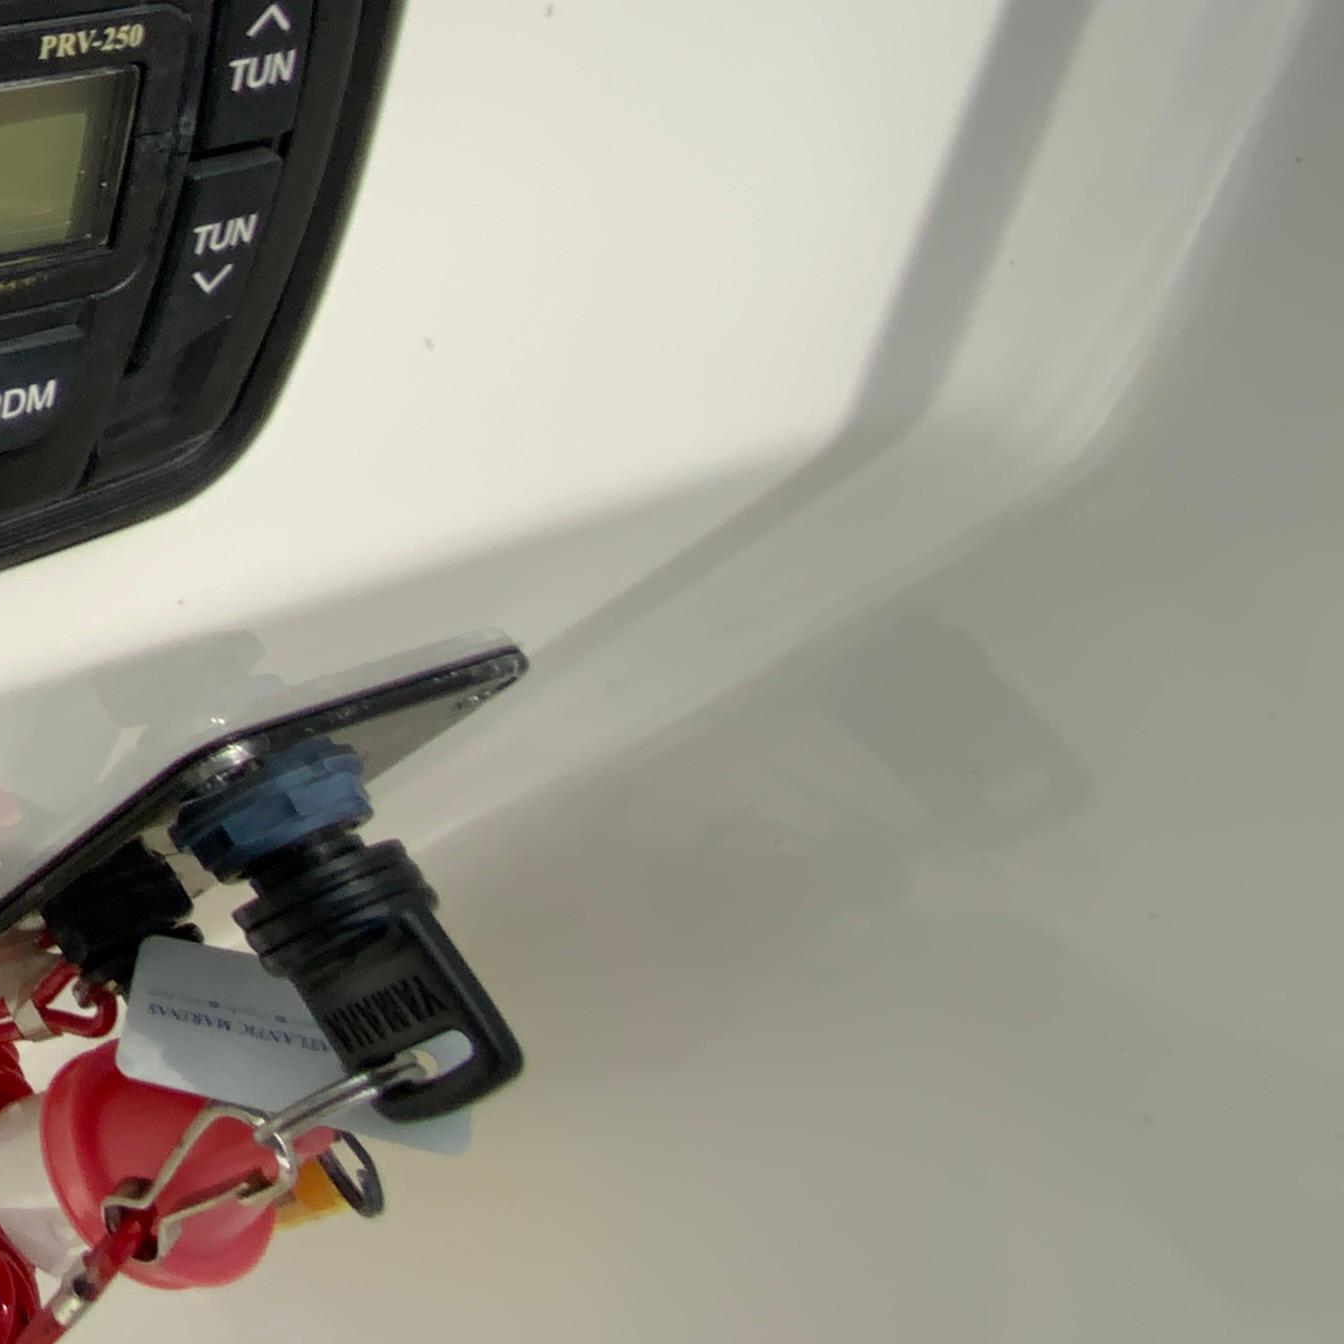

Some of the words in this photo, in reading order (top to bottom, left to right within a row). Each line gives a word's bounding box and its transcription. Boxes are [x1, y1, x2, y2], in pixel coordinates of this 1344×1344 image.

[39, 23, 145, 62] PRV-250
[229, 49, 295, 93] TUN
[193, 214, 257, 256] TUN
[323, 974, 445, 1054] YAMAHA
